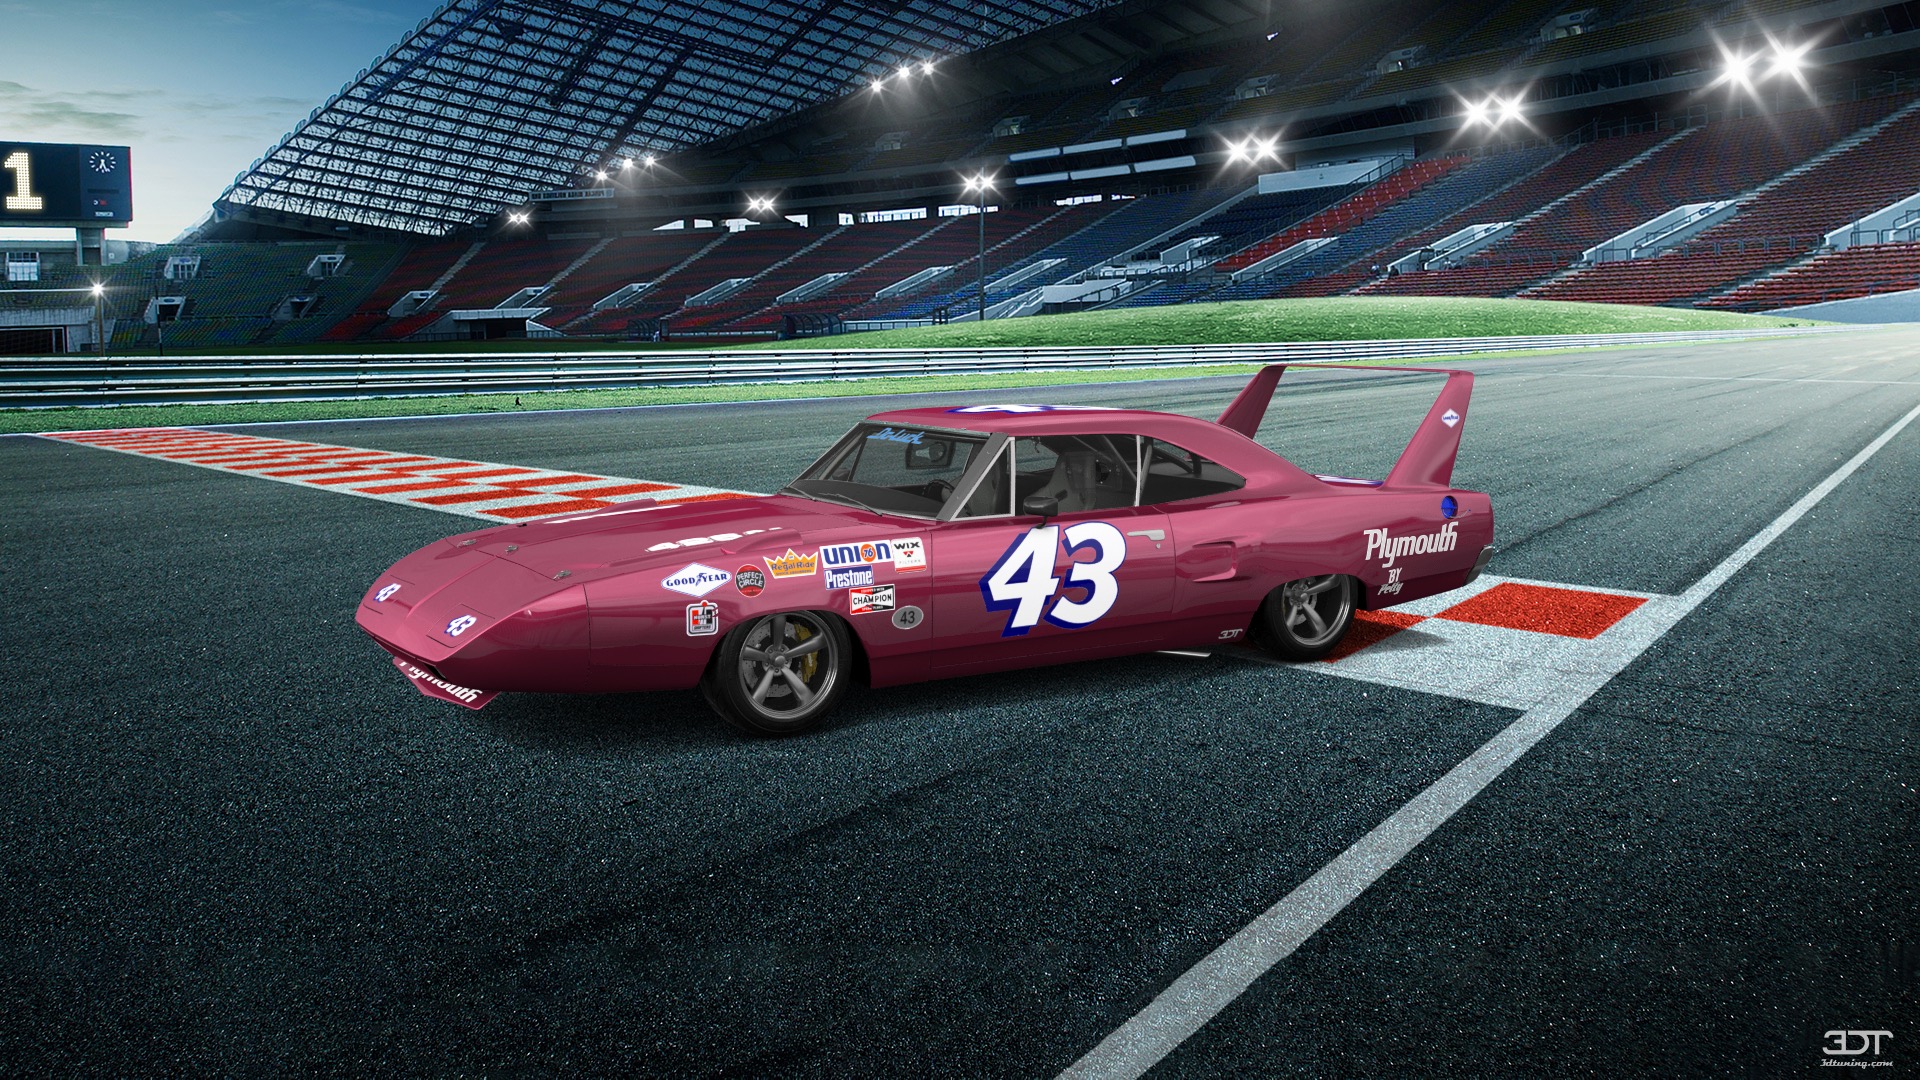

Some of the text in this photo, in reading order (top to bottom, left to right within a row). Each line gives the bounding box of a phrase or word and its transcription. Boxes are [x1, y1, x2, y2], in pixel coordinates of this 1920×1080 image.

[4, 152, 43, 210] 1
[893, 541, 920, 550] WIX
[1363, 521, 1459, 569] Plymouth
[666, 572, 728, 587] GOODYEAR
[737, 571, 763, 581] PERFECT
[738, 578, 764, 588] CIRCLE
[825, 568, 873, 589] Prestone
[977, 520, 1127, 638] 43
[1388, 567, 1402, 584] BY
[853, 593, 892, 605] CHAMPION
[444, 614, 477, 637] 43
[900, 610, 915, 625] 43
